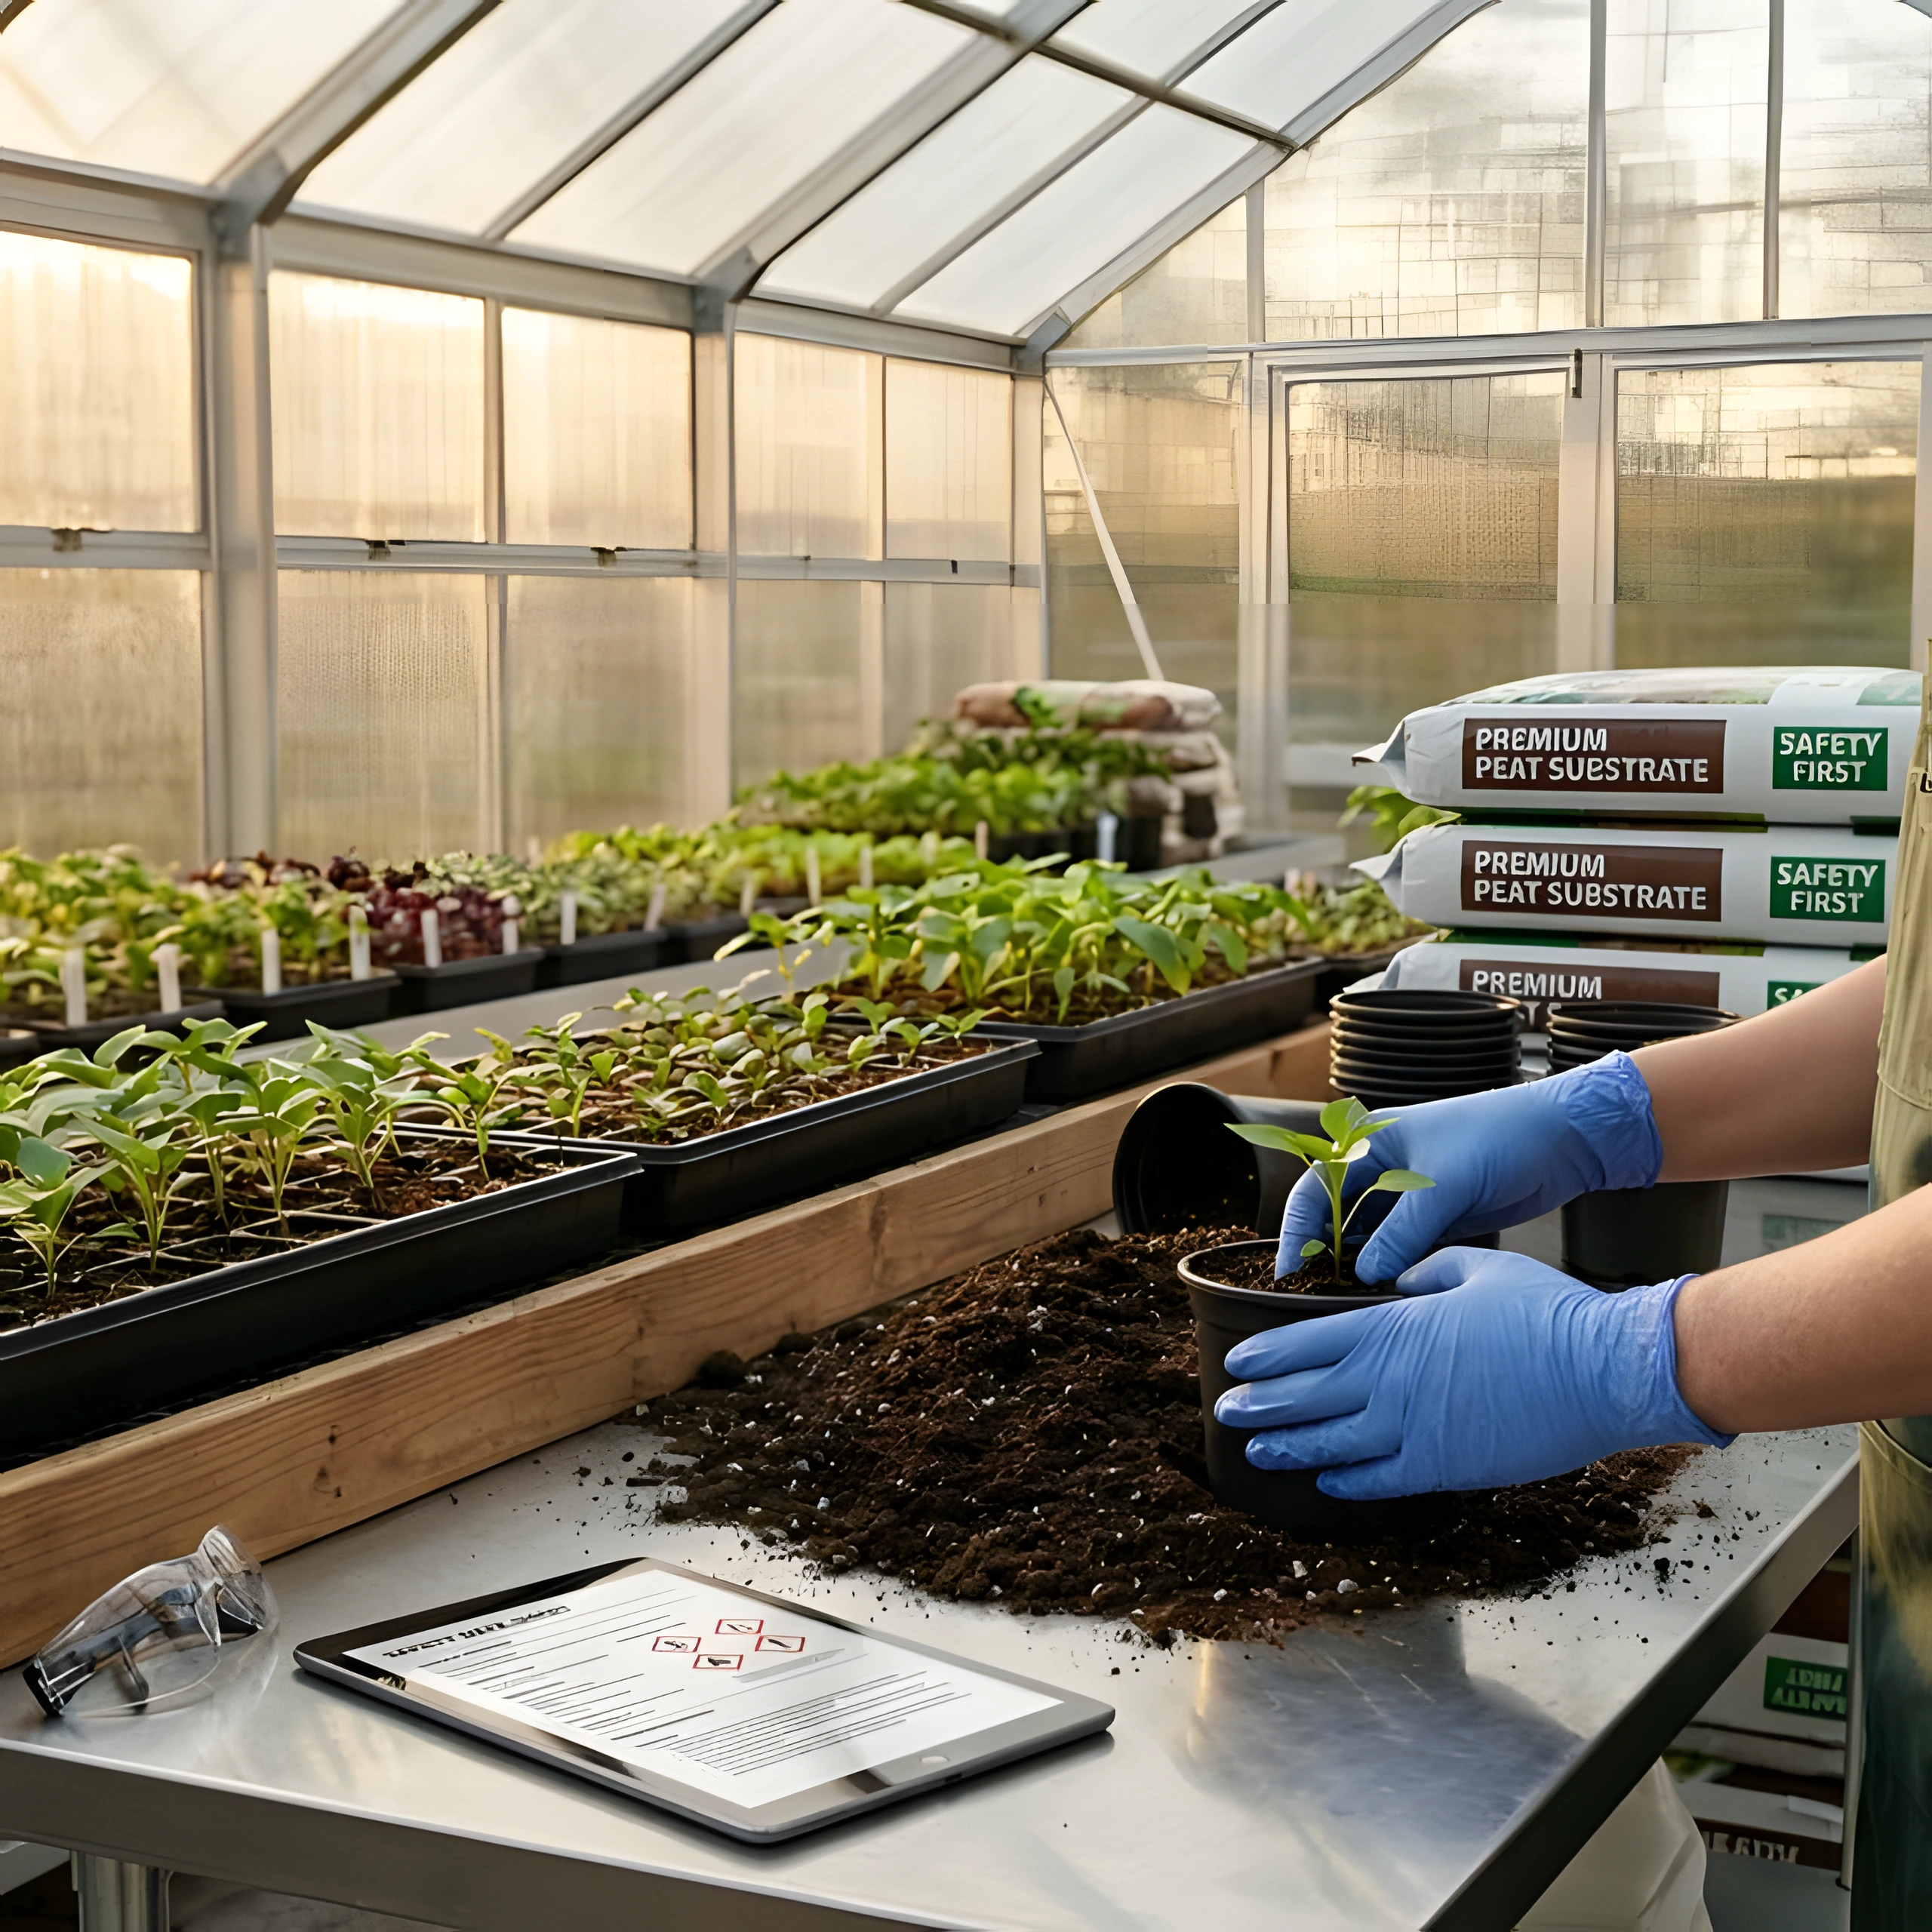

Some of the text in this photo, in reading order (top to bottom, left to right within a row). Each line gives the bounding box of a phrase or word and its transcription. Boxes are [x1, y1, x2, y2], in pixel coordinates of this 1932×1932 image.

[1475, 727, 1607, 752] PREMIUM
[1780, 732, 1882, 756] SAFETY
[1475, 756, 1709, 783] PEAT SUBSTRATE
[1793, 761, 1867, 783] FIRST
[1475, 851, 1604, 878] PREMIUM
[1777, 863, 1878, 888] SAFETY
[1474, 879, 1706, 910] PEAT SUBSTRATE
[1790, 891, 1864, 914] FIRST
[1472, 970, 1602, 1000] PREMIUM
